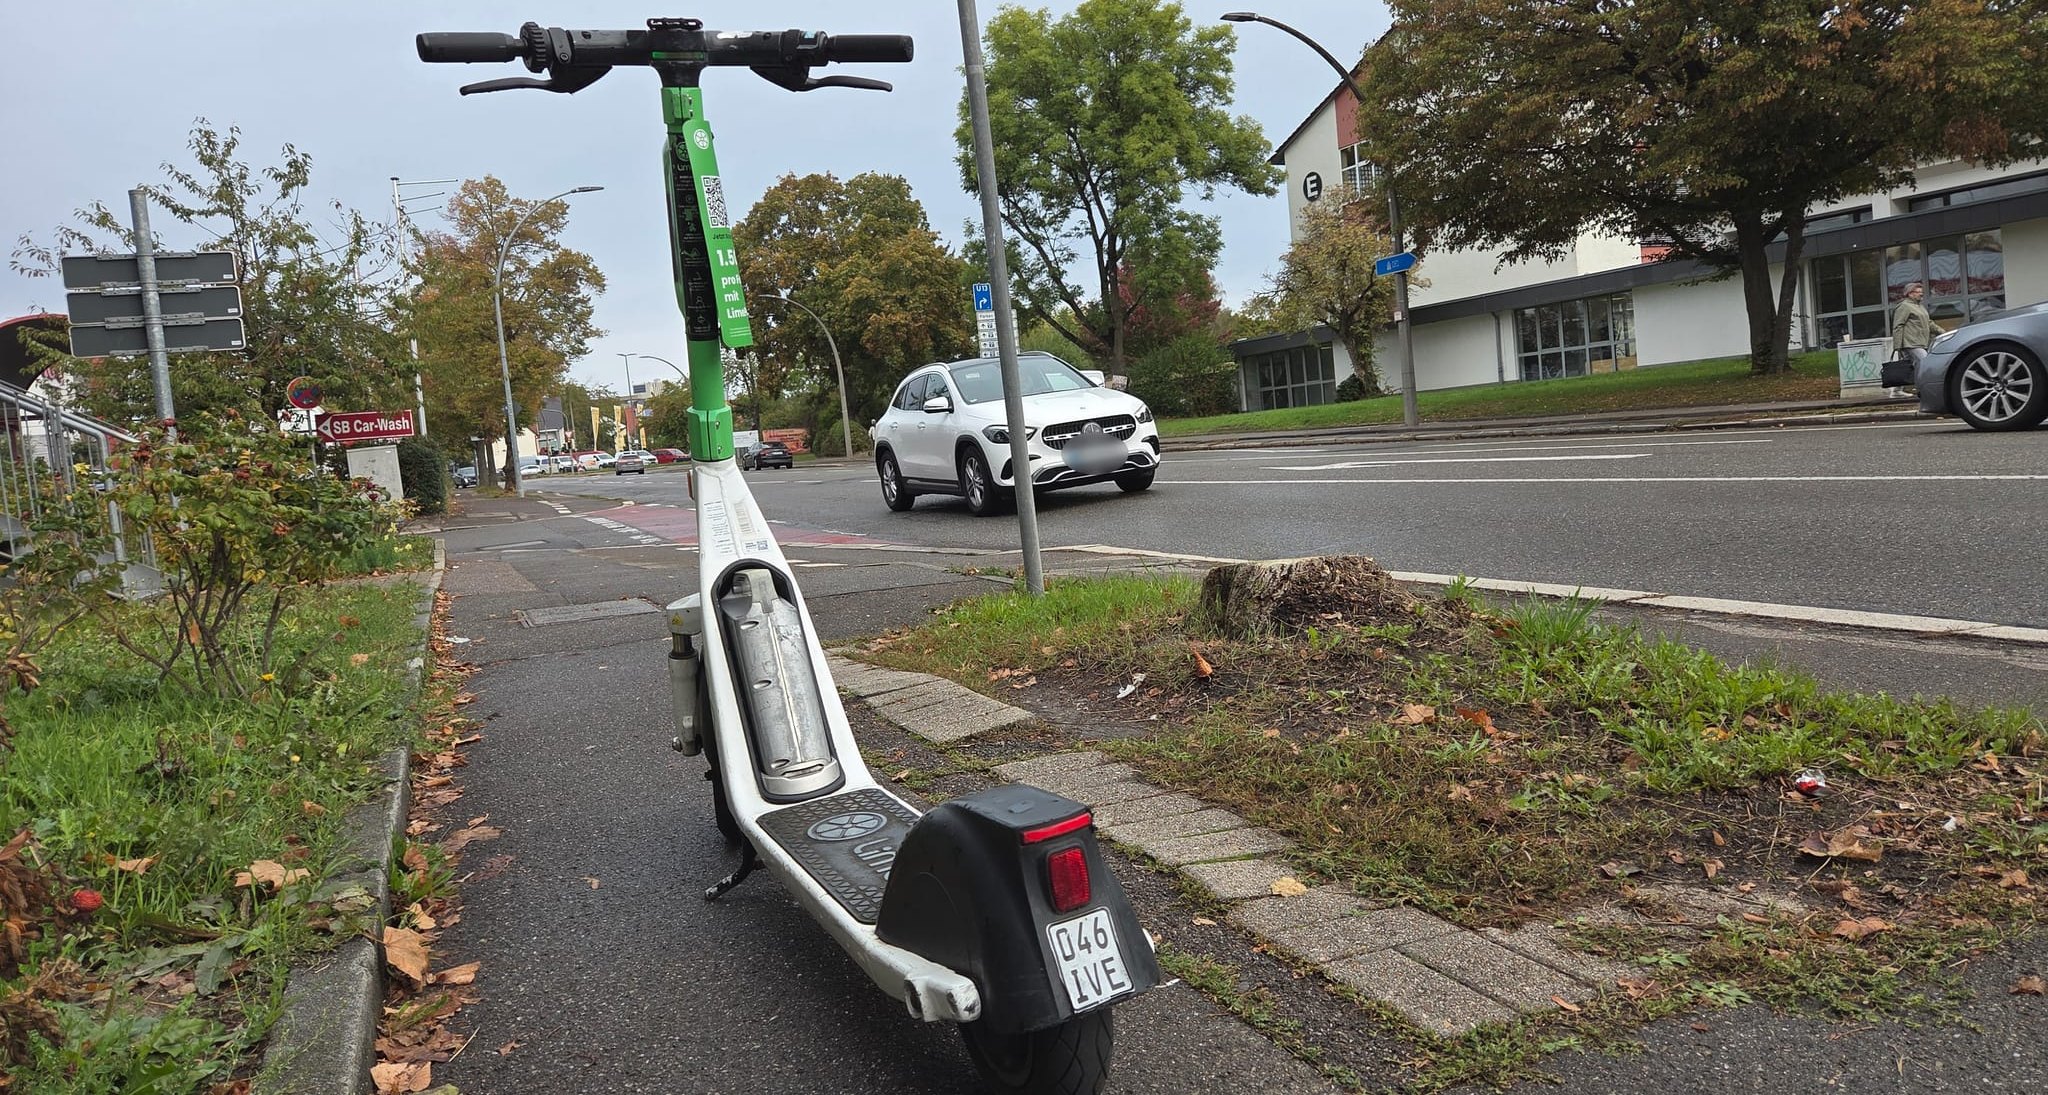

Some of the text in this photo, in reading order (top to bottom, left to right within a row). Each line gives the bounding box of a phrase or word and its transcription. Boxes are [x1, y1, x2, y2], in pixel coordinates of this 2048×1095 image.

[1306, 174, 1319, 198] E
[724, 290, 739, 302] mit
[333, 417, 410, 434] SB Car-Wash
[853, 837, 897, 881] Lim
[1056, 916, 1109, 962] 046
[1071, 957, 1126, 1004] IVE
